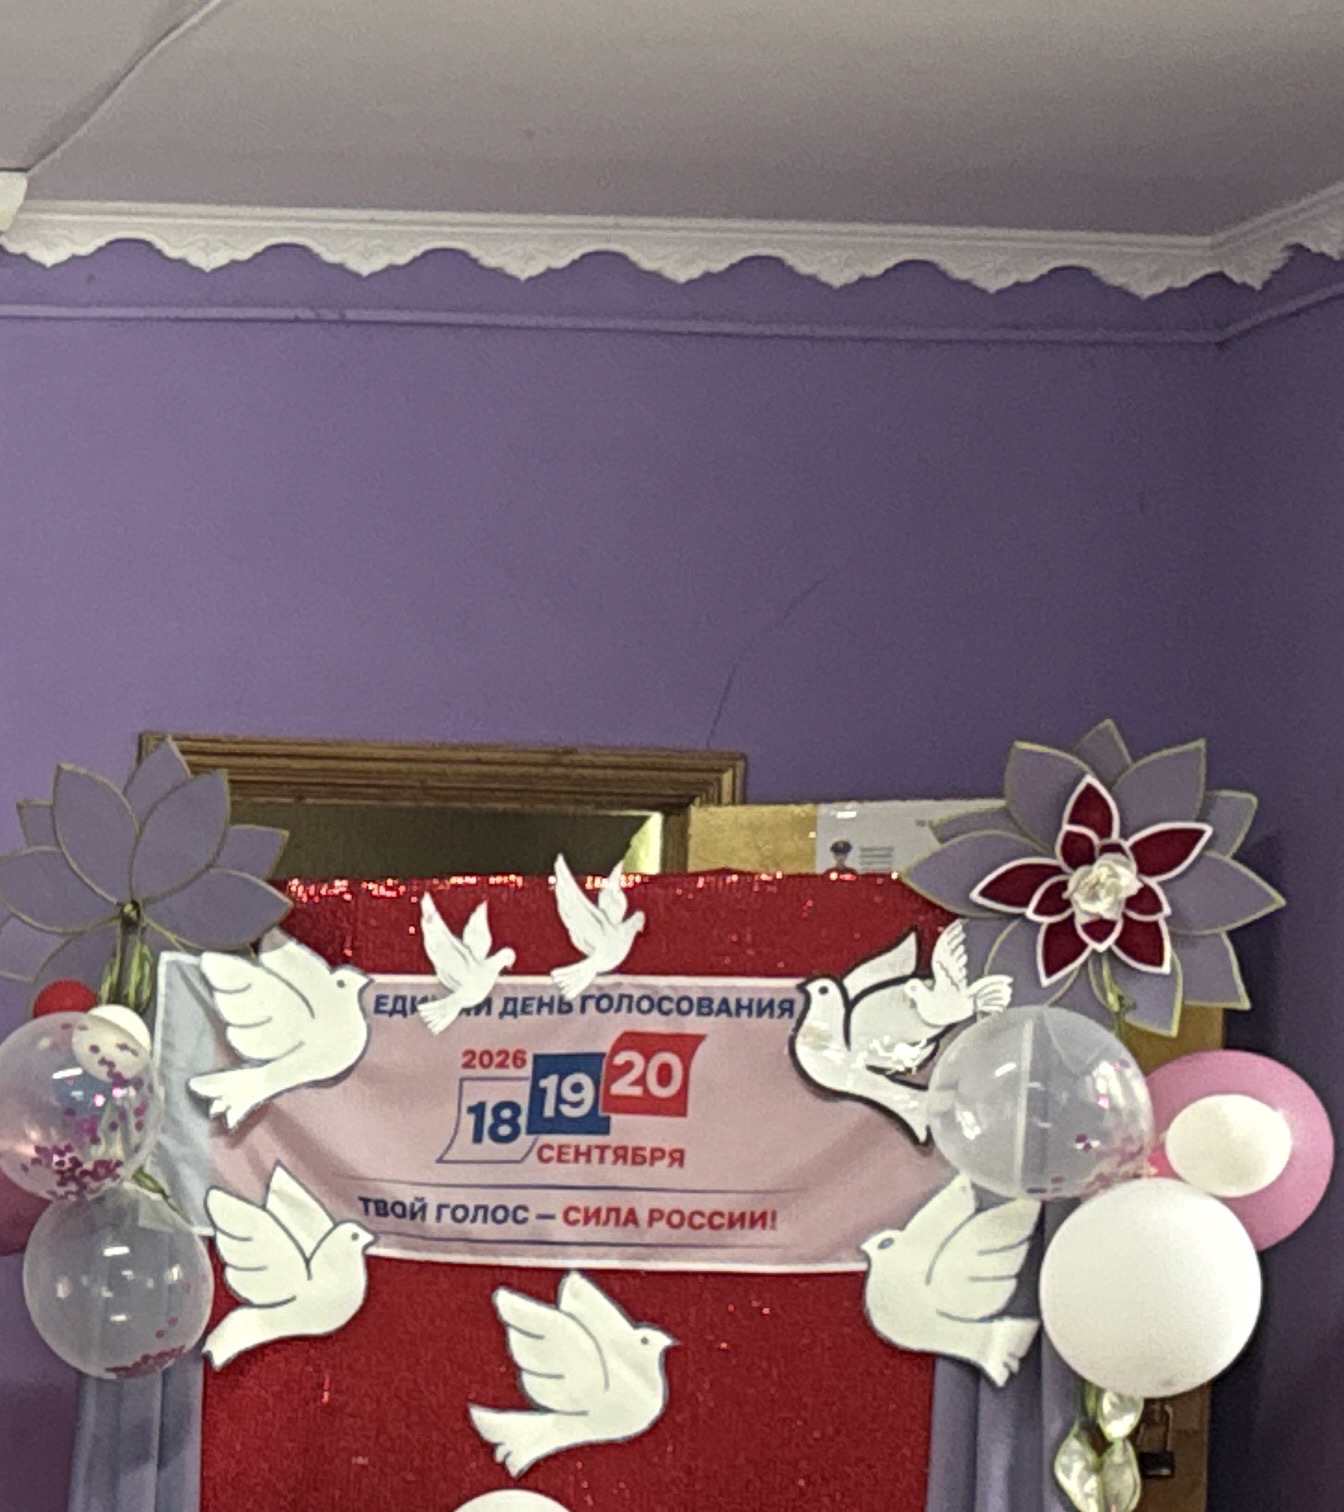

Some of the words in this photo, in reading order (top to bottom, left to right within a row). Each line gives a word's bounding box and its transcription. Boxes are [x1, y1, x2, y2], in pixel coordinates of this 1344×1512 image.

[498, 995, 573, 1020] ДЕНЬ
[579, 993, 795, 1019] ГОЛОСОВАНИЯ
[461, 1049, 527, 1070] 2026
[466, 1100, 522, 1144] 18
[538, 1072, 596, 1119] 19
[609, 1050, 684, 1098] 20
[535, 1144, 686, 1169] СЕНТЯБРЯ
[358, 1196, 428, 1223] ТВОЙ
[435, 1203, 531, 1225] ГОЛОС
[562, 1205, 640, 1228] СИЛА
[647, 1207, 777, 1231] РОССИИ!
